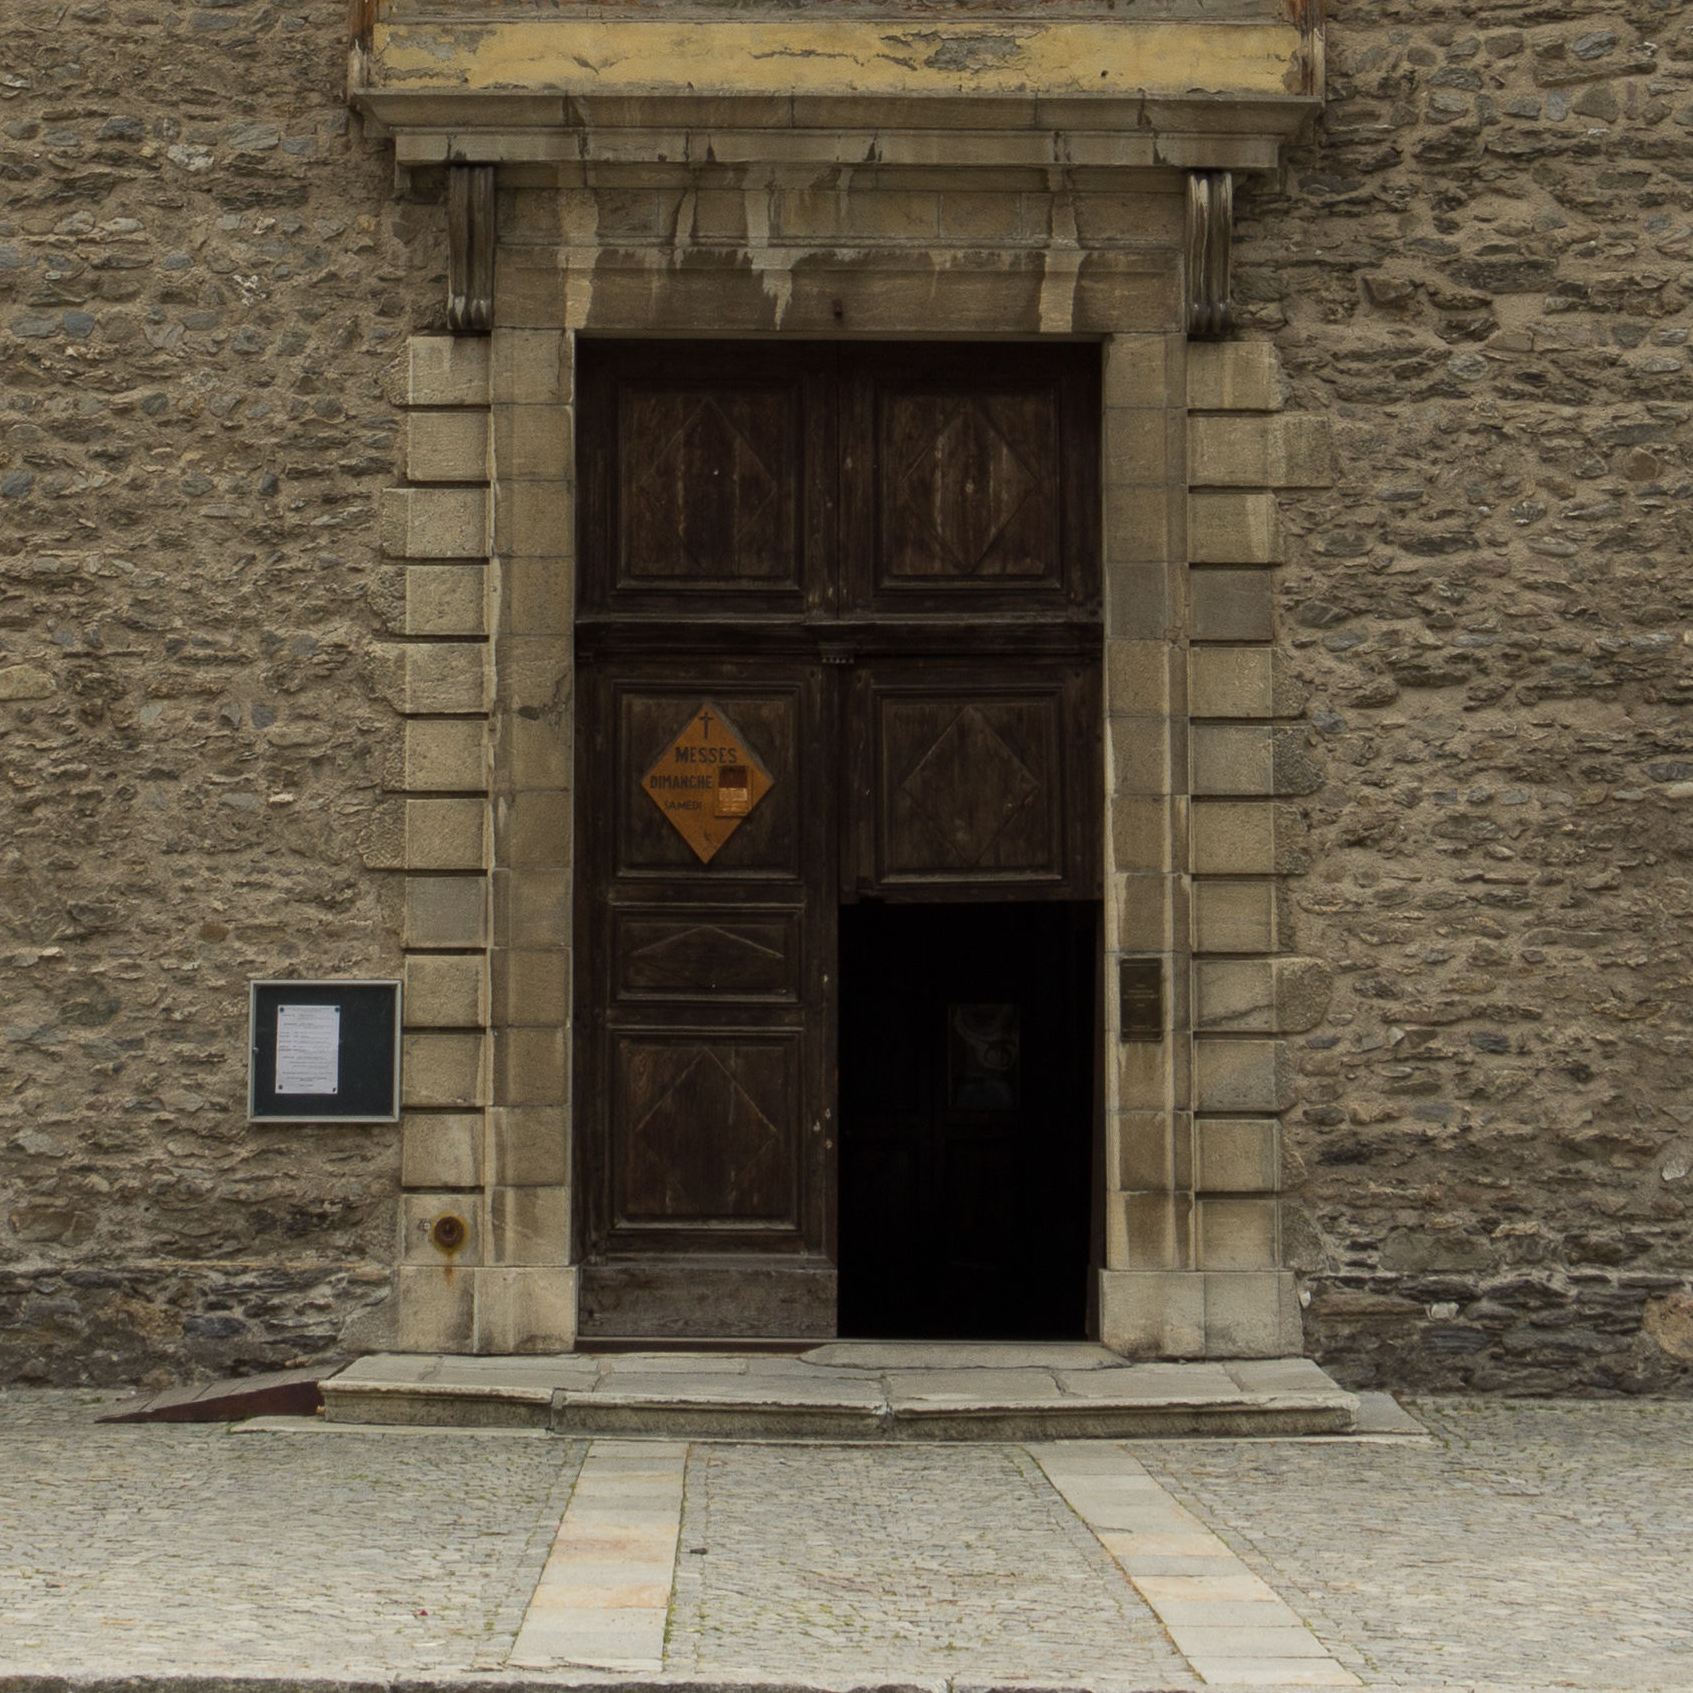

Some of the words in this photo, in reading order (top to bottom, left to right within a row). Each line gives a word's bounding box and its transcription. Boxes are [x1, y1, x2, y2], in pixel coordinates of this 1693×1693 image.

[675, 747, 738, 764] MESSES
[649, 775, 712, 790] DIMANCHE
[663, 801, 702, 811] SAMEDI
